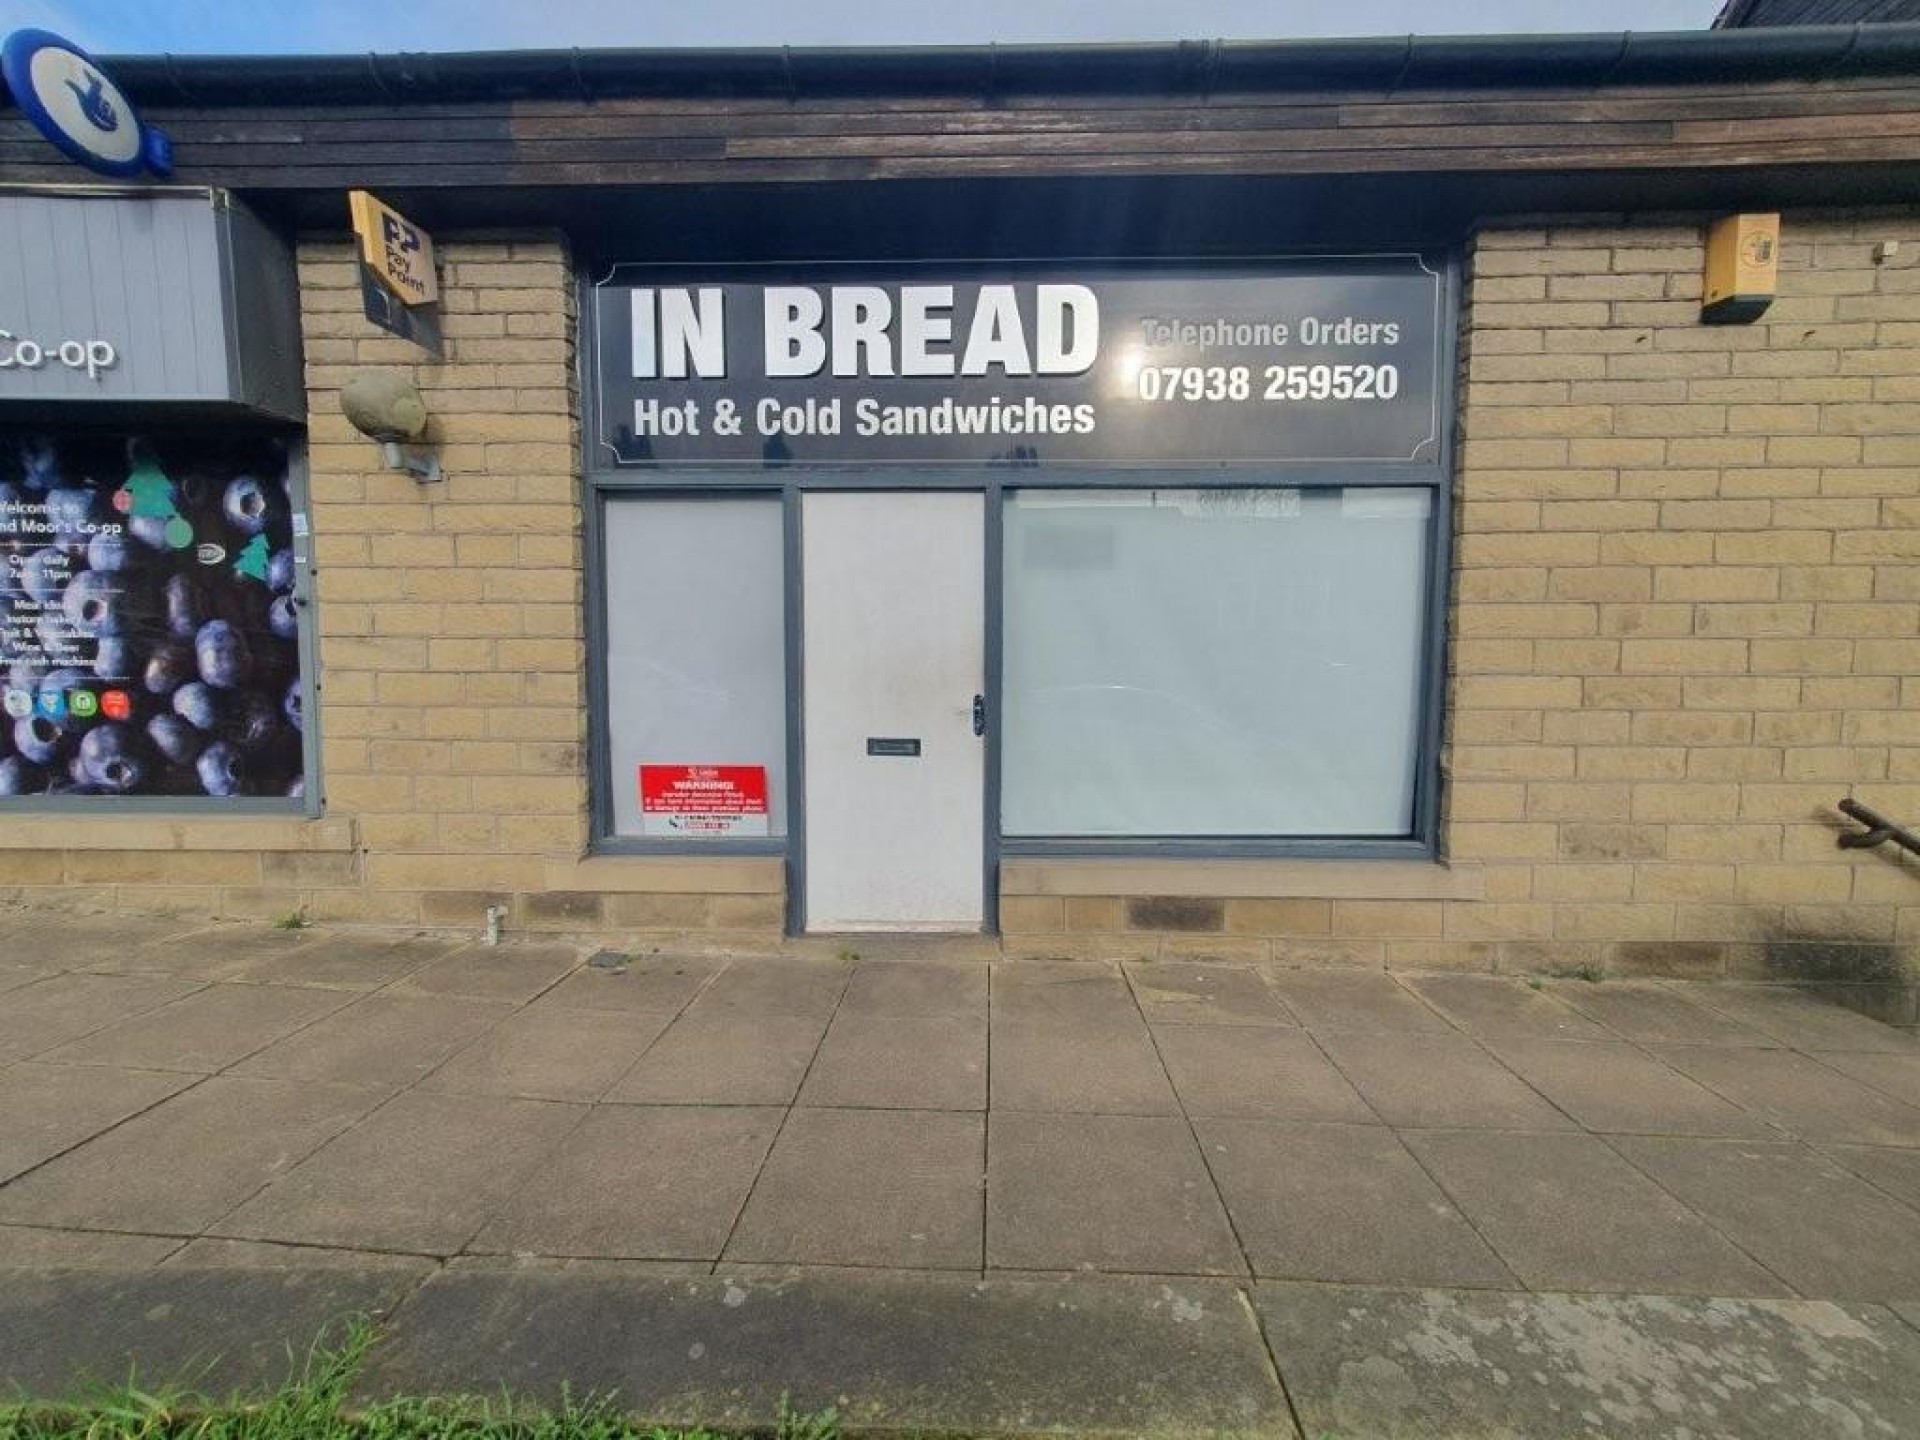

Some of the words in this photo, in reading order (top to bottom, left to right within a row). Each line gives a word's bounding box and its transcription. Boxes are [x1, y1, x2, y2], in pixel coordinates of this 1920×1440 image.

[631, 286, 727, 379] IN
[764, 284, 1102, 378] BREAD
[1141, 318, 1289, 350] Telephone
[1299, 317, 1400, 345] Orders
[1139, 366, 1250, 401] 07938
[1264, 364, 1398, 400] 259520
[635, 398, 701, 435] Hot
[712, 398, 741, 435] &
[757, 397, 841, 435] Cold
[856, 396, 1097, 434] Sandwiches
[77, 519, 122, 536] Co-op
